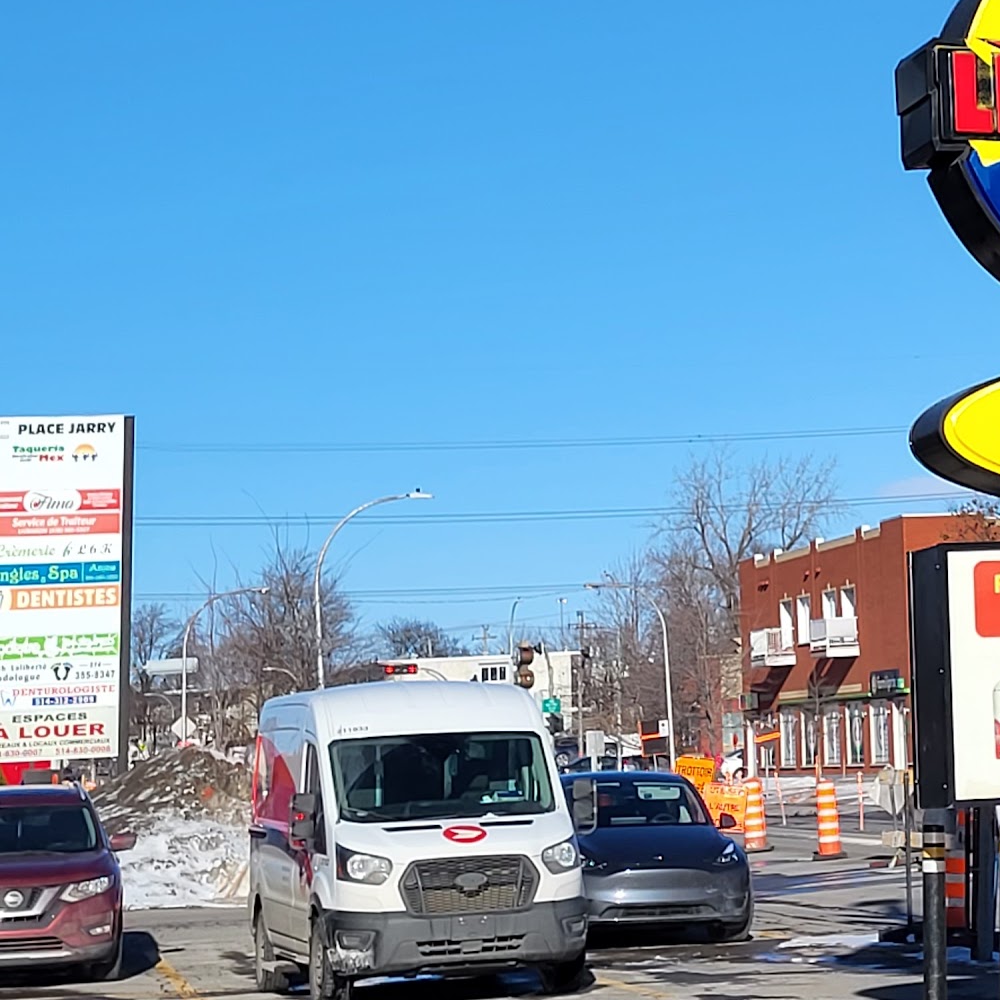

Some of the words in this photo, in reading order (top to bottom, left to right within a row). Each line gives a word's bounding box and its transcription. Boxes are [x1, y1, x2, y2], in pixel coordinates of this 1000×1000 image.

[18, 423, 64, 435] PLACE
[68, 422, 116, 434] JARRY
[12, 445, 65, 454] Taqueria
[47, 516, 59, 527] de
[48, 565, 78, 582] Spa
[16, 587, 117, 608] DENTISTES
[12, 685, 116, 697] DENTUROLOGISTE
[12, 712, 87, 723] ESPACES
[19, 723, 104, 739] LOUER
